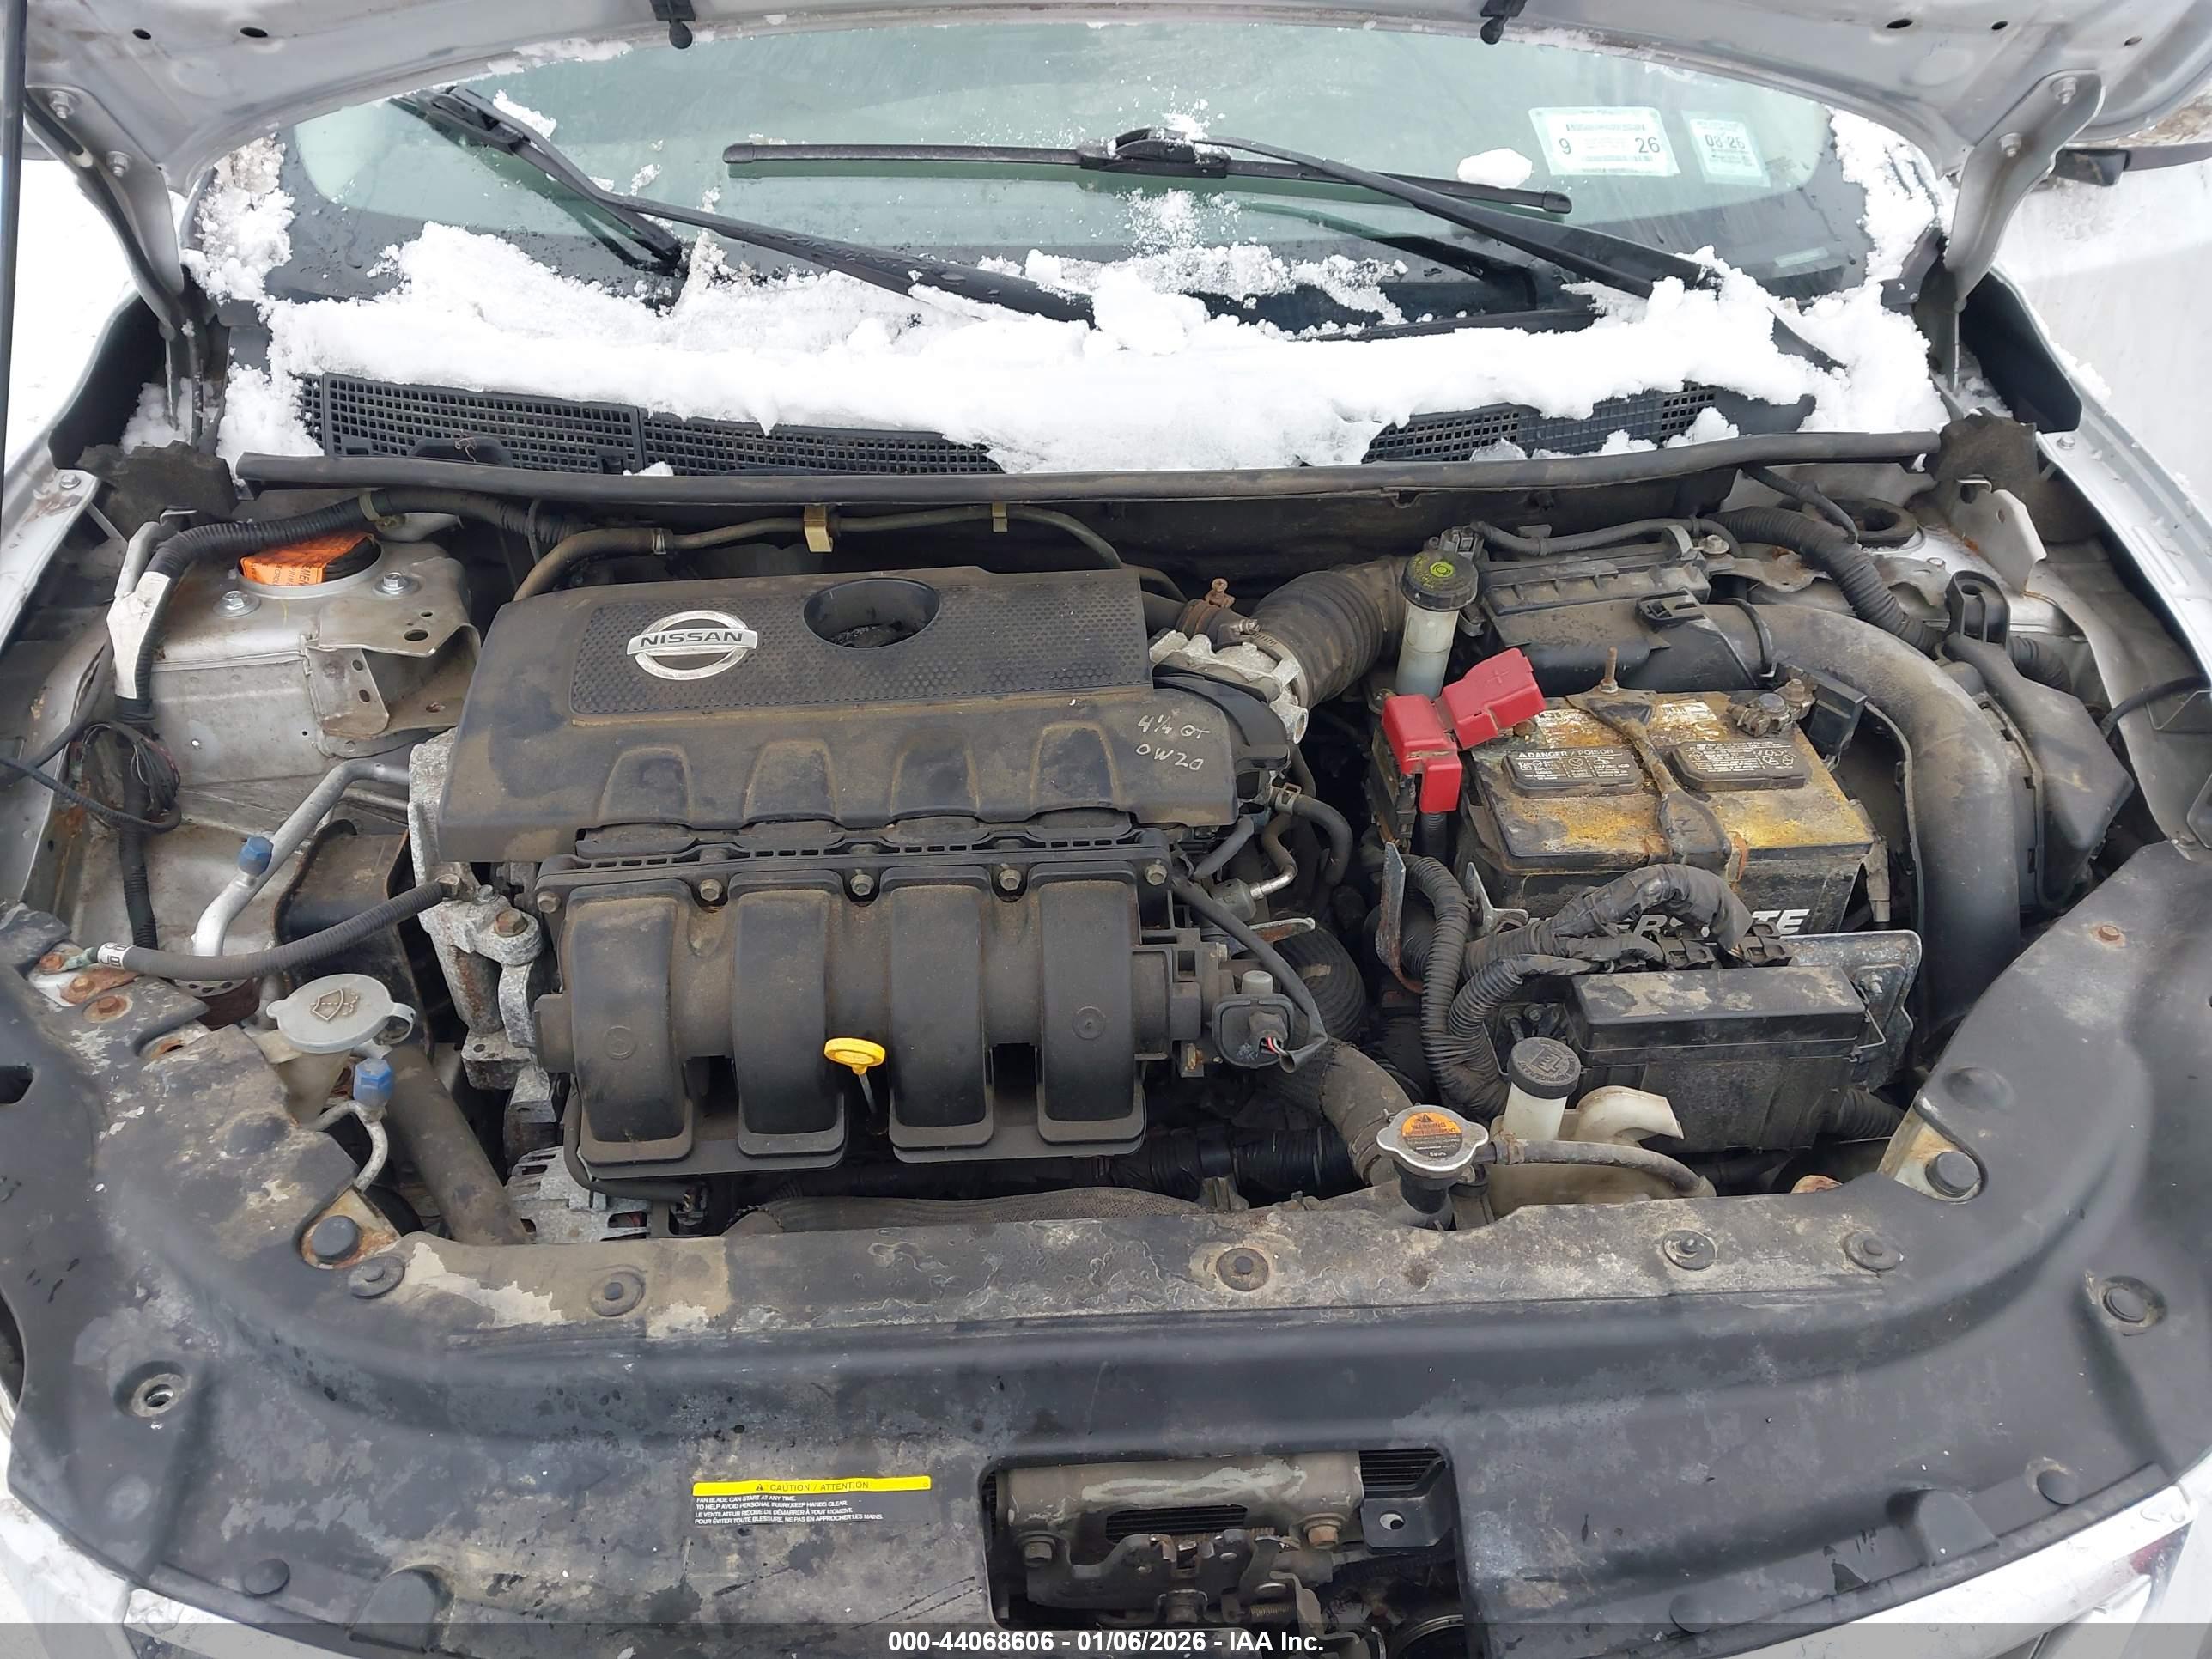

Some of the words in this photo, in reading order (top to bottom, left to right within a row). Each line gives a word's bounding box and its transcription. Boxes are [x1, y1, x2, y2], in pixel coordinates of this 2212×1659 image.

[1559, 137, 1572, 155] 9
[1635, 137, 1661, 154] 26
[640, 631, 743, 647] NISSAN
[1577, 748, 1614, 757] POISON
[769, 1483, 811, 1492] CAUTION
[820, 1481, 870, 1492] ATTENTION
[712, 1516, 732, 1525] ÉVITER
